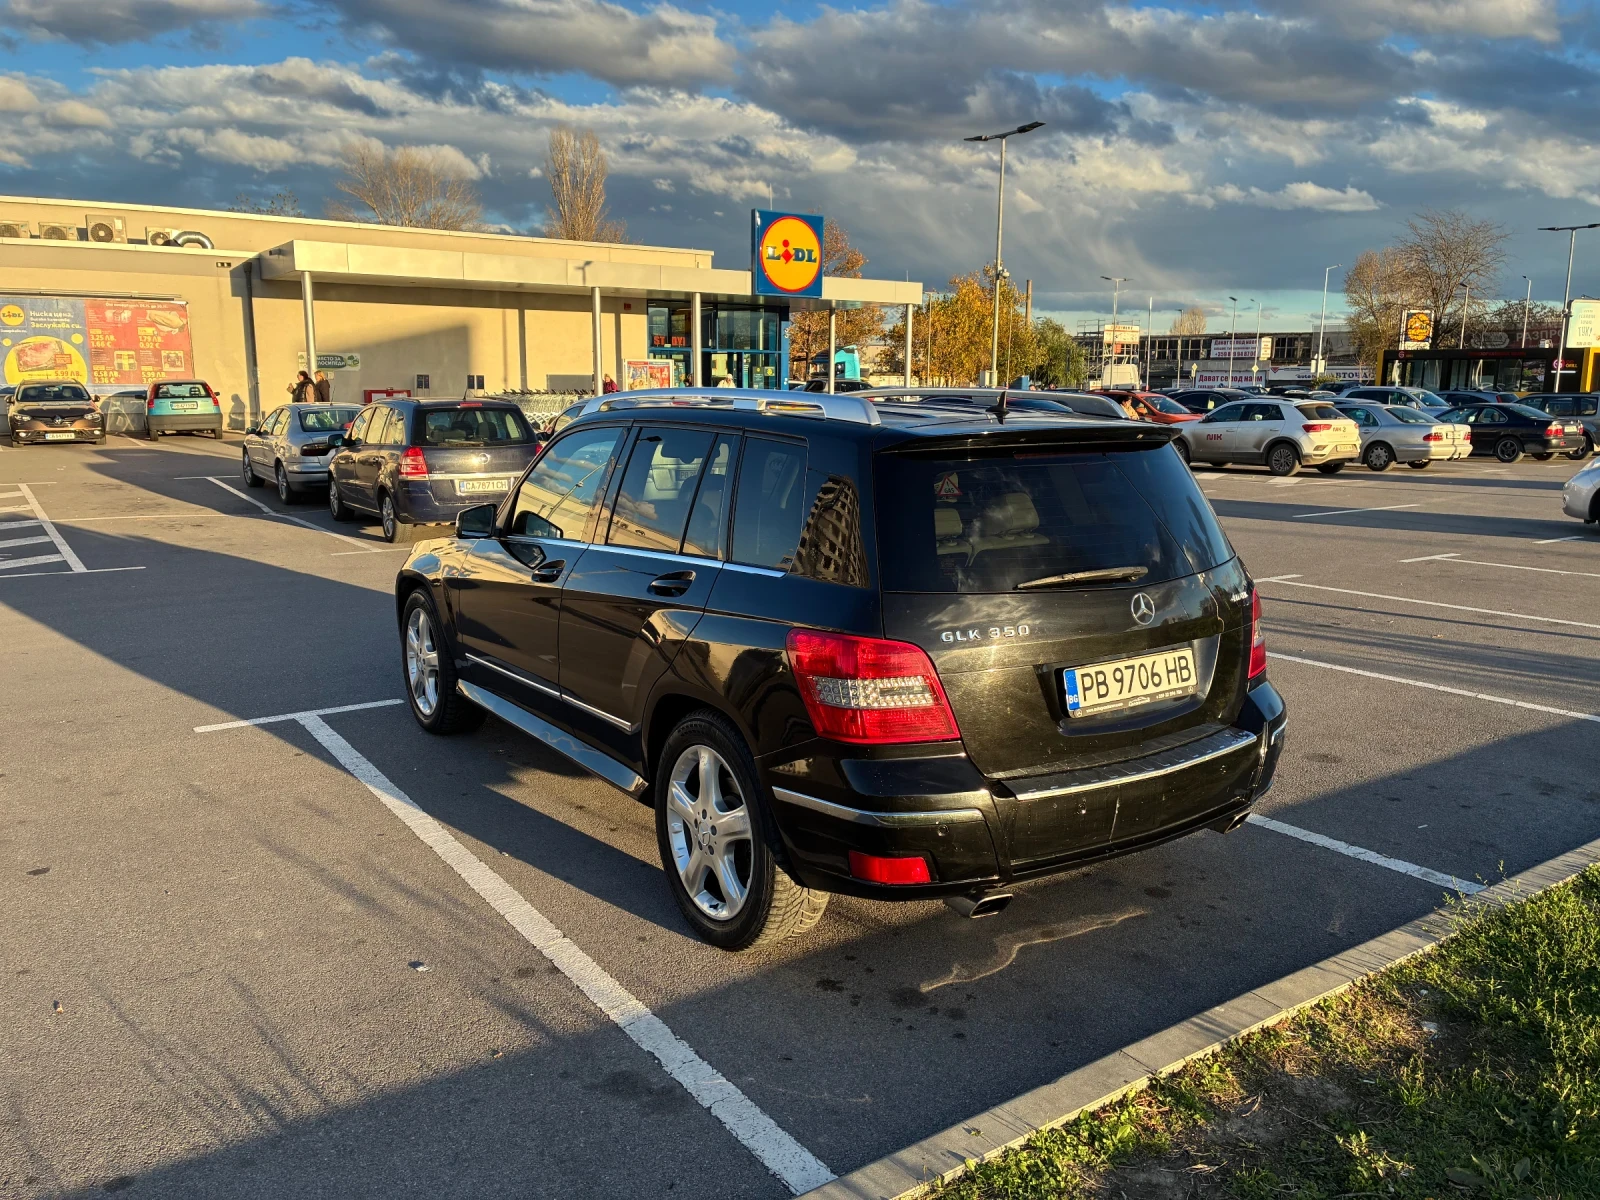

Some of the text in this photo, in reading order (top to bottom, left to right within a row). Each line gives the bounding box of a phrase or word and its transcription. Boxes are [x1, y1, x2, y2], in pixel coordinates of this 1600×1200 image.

[1198, 374, 1219, 382] Дават
[1206, 433, 1223, 441] NIK
[941, 625, 1030, 643] GLK 350
[1080, 655, 1192, 702] PB 9706 HB
[1068, 694, 1079, 704] BG
